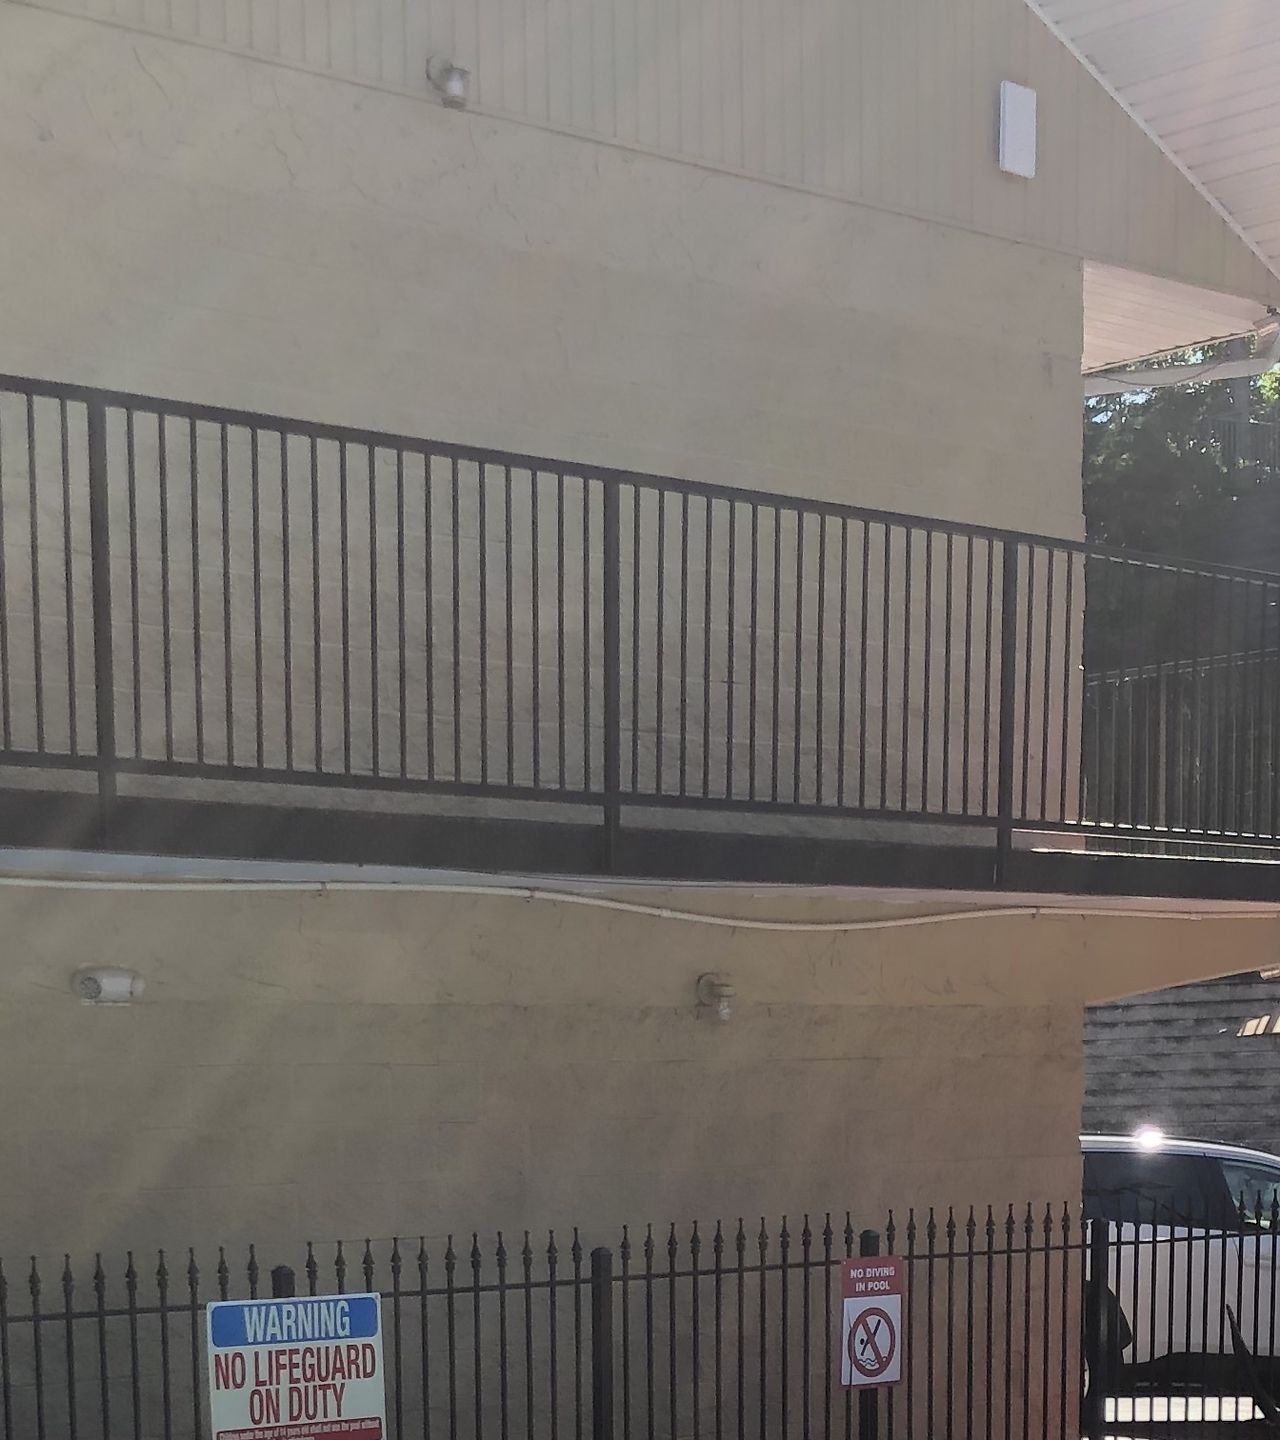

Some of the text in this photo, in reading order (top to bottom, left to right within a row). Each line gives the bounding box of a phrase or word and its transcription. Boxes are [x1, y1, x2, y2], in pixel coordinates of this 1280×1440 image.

[850, 1266, 895, 1278] NO DIVING
[855, 1280, 890, 1292] IN POOL
[244, 1300, 350, 1343] WARNING
[214, 1343, 376, 1390] NO LIFEGUARD
[249, 1383, 346, 1425] ON DUTY
